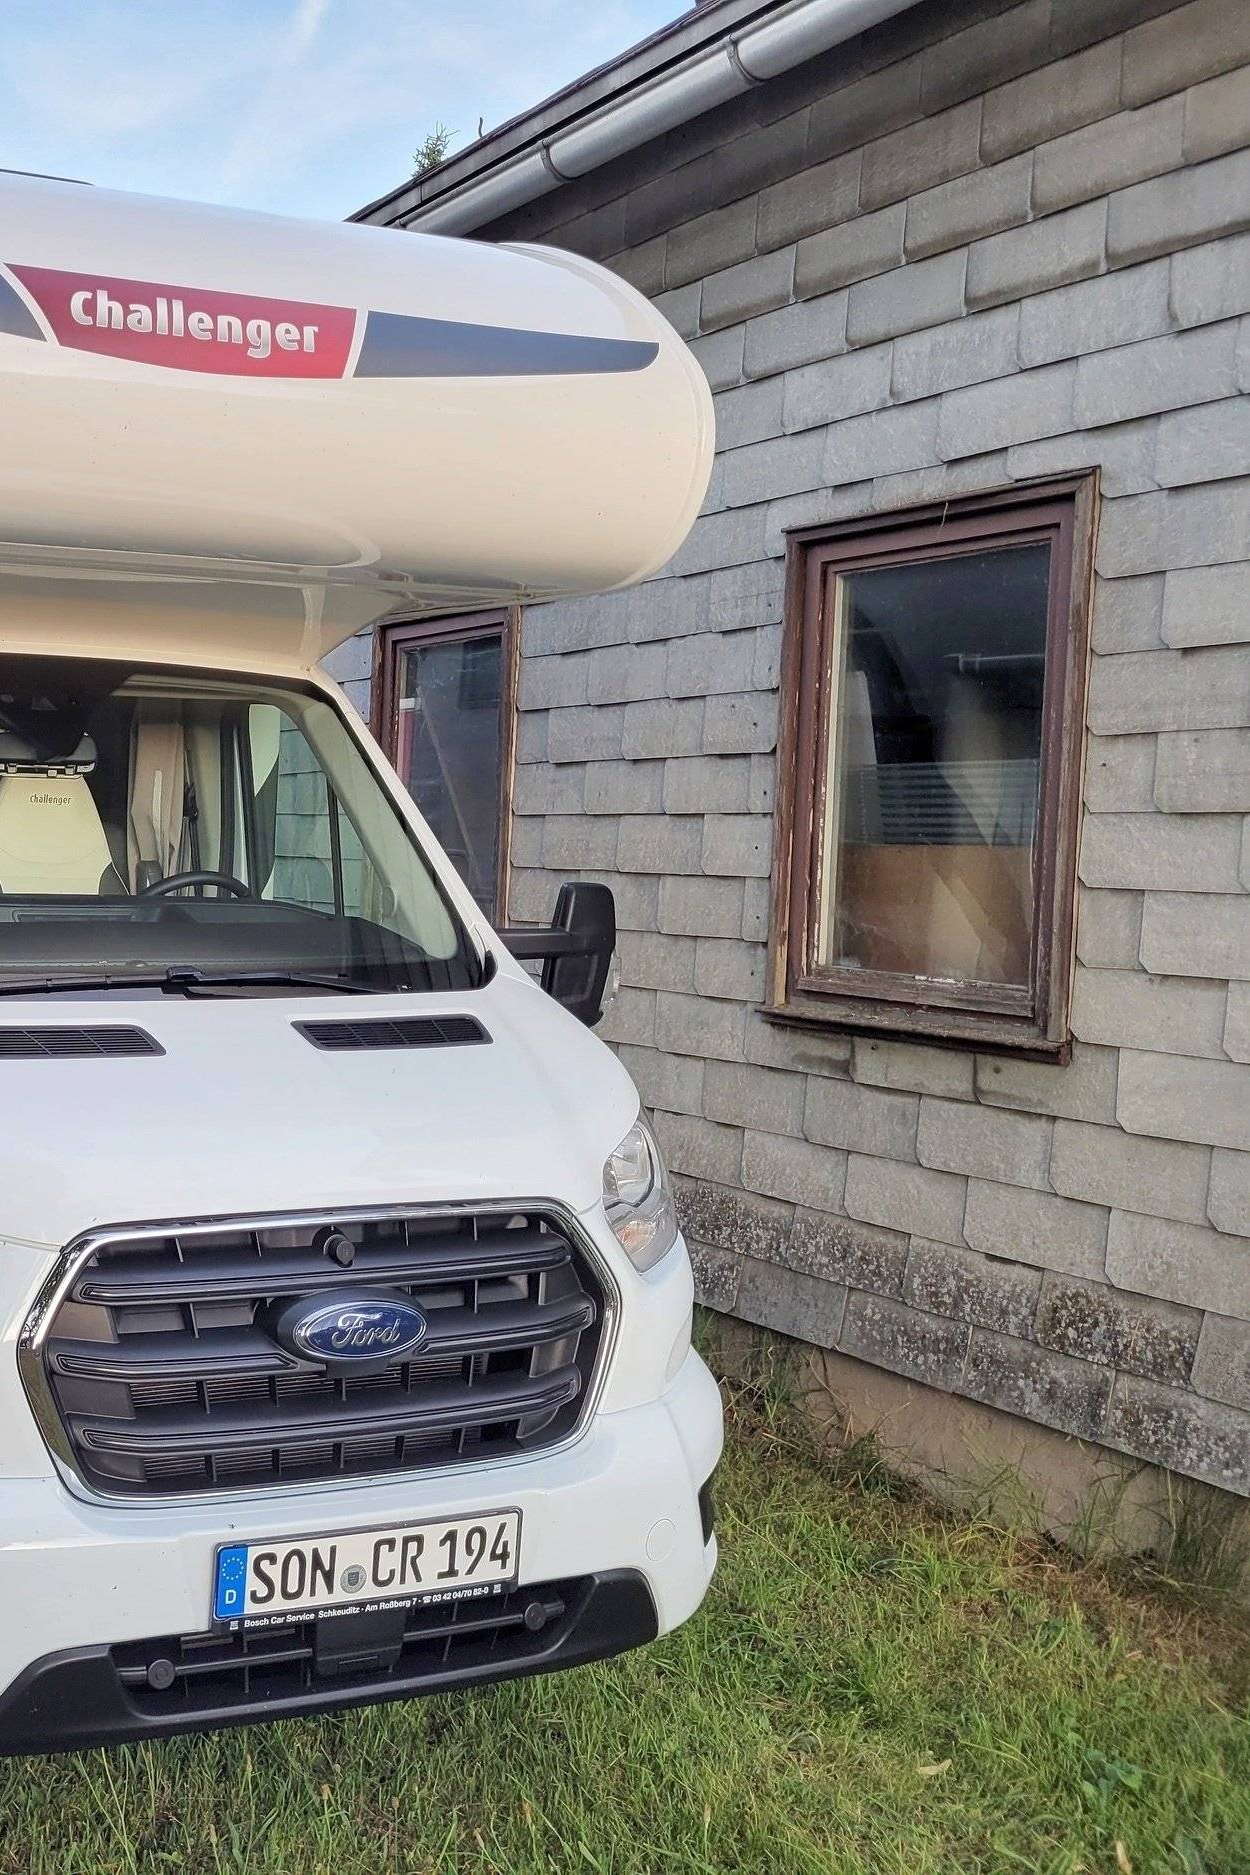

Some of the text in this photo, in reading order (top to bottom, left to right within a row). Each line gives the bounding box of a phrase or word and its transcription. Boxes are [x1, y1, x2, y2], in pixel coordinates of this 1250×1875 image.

[70, 289, 318, 358] Challenger
[331, 1313, 400, 1349] Ford
[249, 1522, 511, 1604] SON CR 194
[225, 1589, 237, 1605] D
[244, 1617, 269, 1628] Bosch
[270, 1615, 285, 1625] Car
[286, 1612, 315, 1622] Service
[318, 1606, 360, 1618] Schkeuditz
[365, 1603, 378, 1612] Am
[432, 1593, 442, 1602] 03
